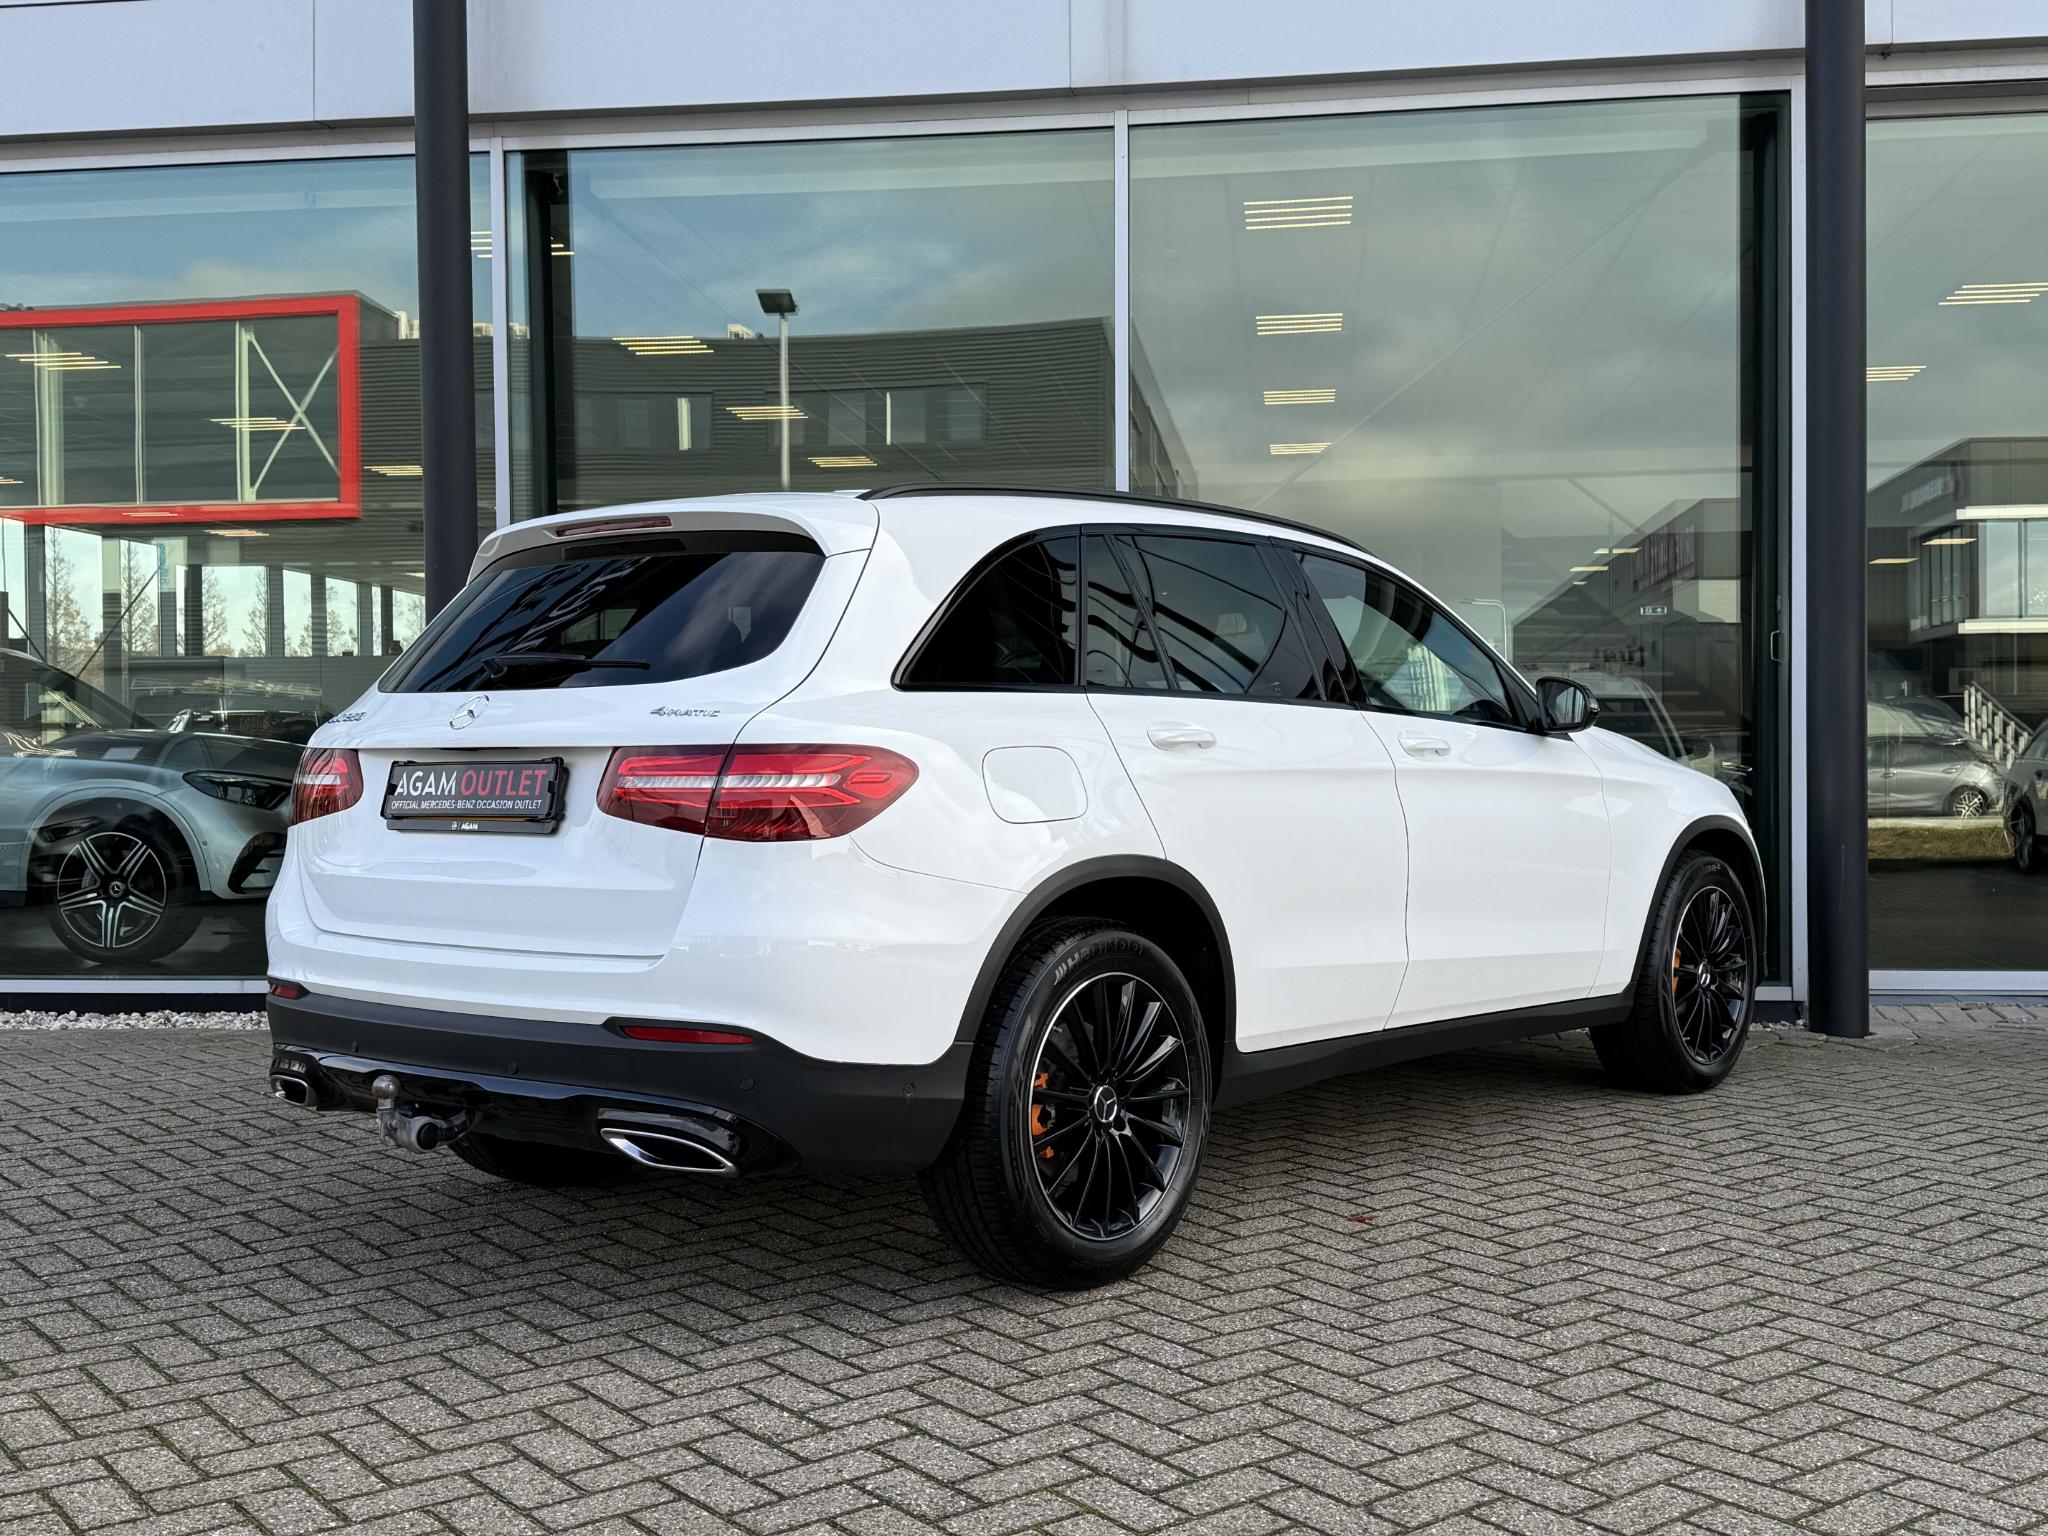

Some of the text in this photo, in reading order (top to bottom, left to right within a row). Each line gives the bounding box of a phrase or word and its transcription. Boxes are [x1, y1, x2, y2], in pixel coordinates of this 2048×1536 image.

[394, 769, 548, 796] AGAM OUTLET
[391, 799, 542, 809] OFFICIAL MERCEDES-BENZ OCCASION OUTLET
[461, 822, 479, 830] AGAM
